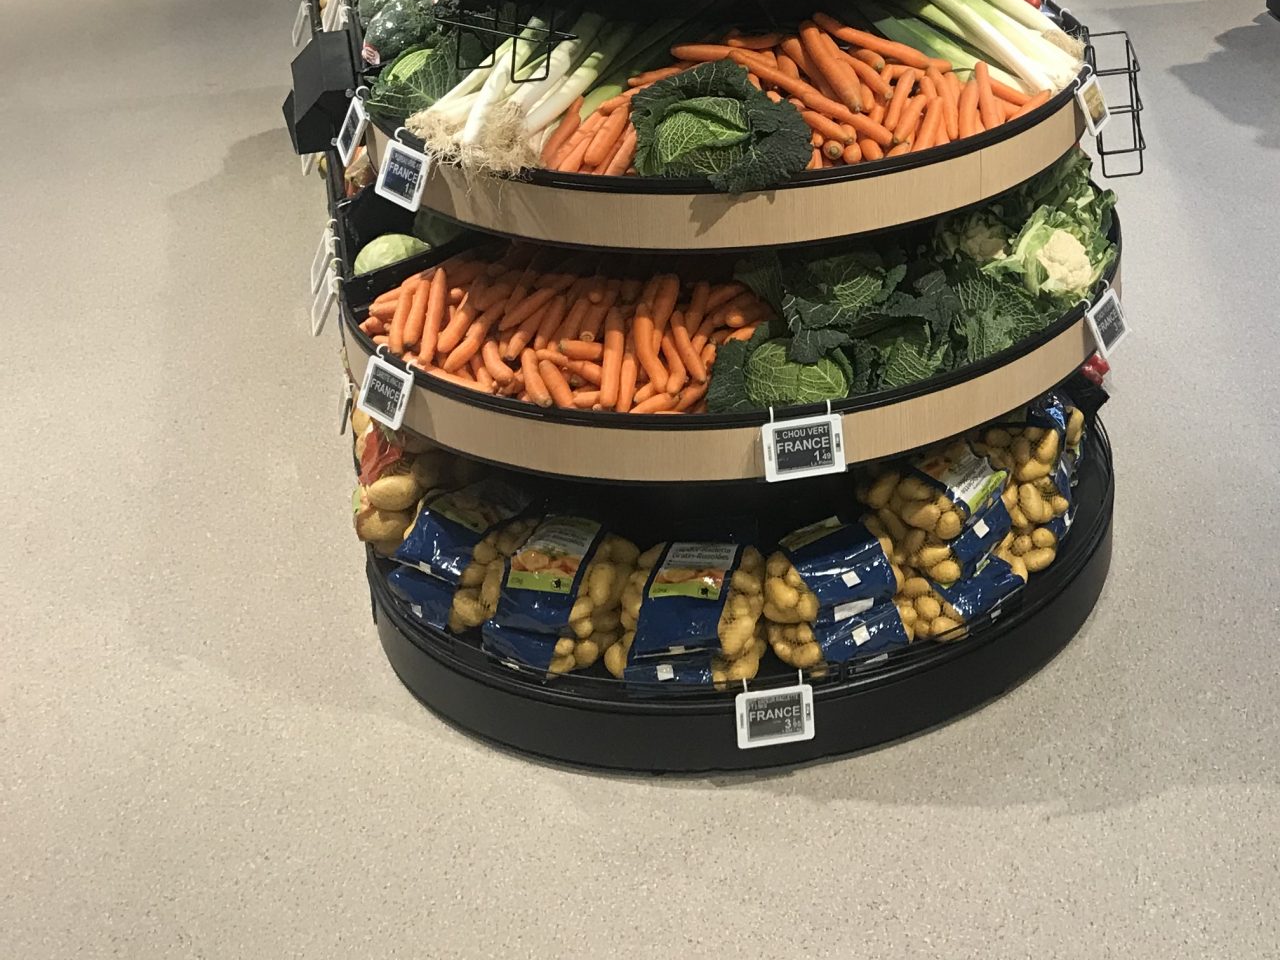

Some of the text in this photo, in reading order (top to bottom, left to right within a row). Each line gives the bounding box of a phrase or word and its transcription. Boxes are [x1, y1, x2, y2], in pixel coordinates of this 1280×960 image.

[388, 162, 419, 184] FRANCE
[370, 378, 400, 402] FRANCE
[782, 429, 806, 439] CHOU
[807, 426, 829, 436] VERT
[776, 436, 830, 455] FRANCE
[749, 705, 801, 722] FRANCE
